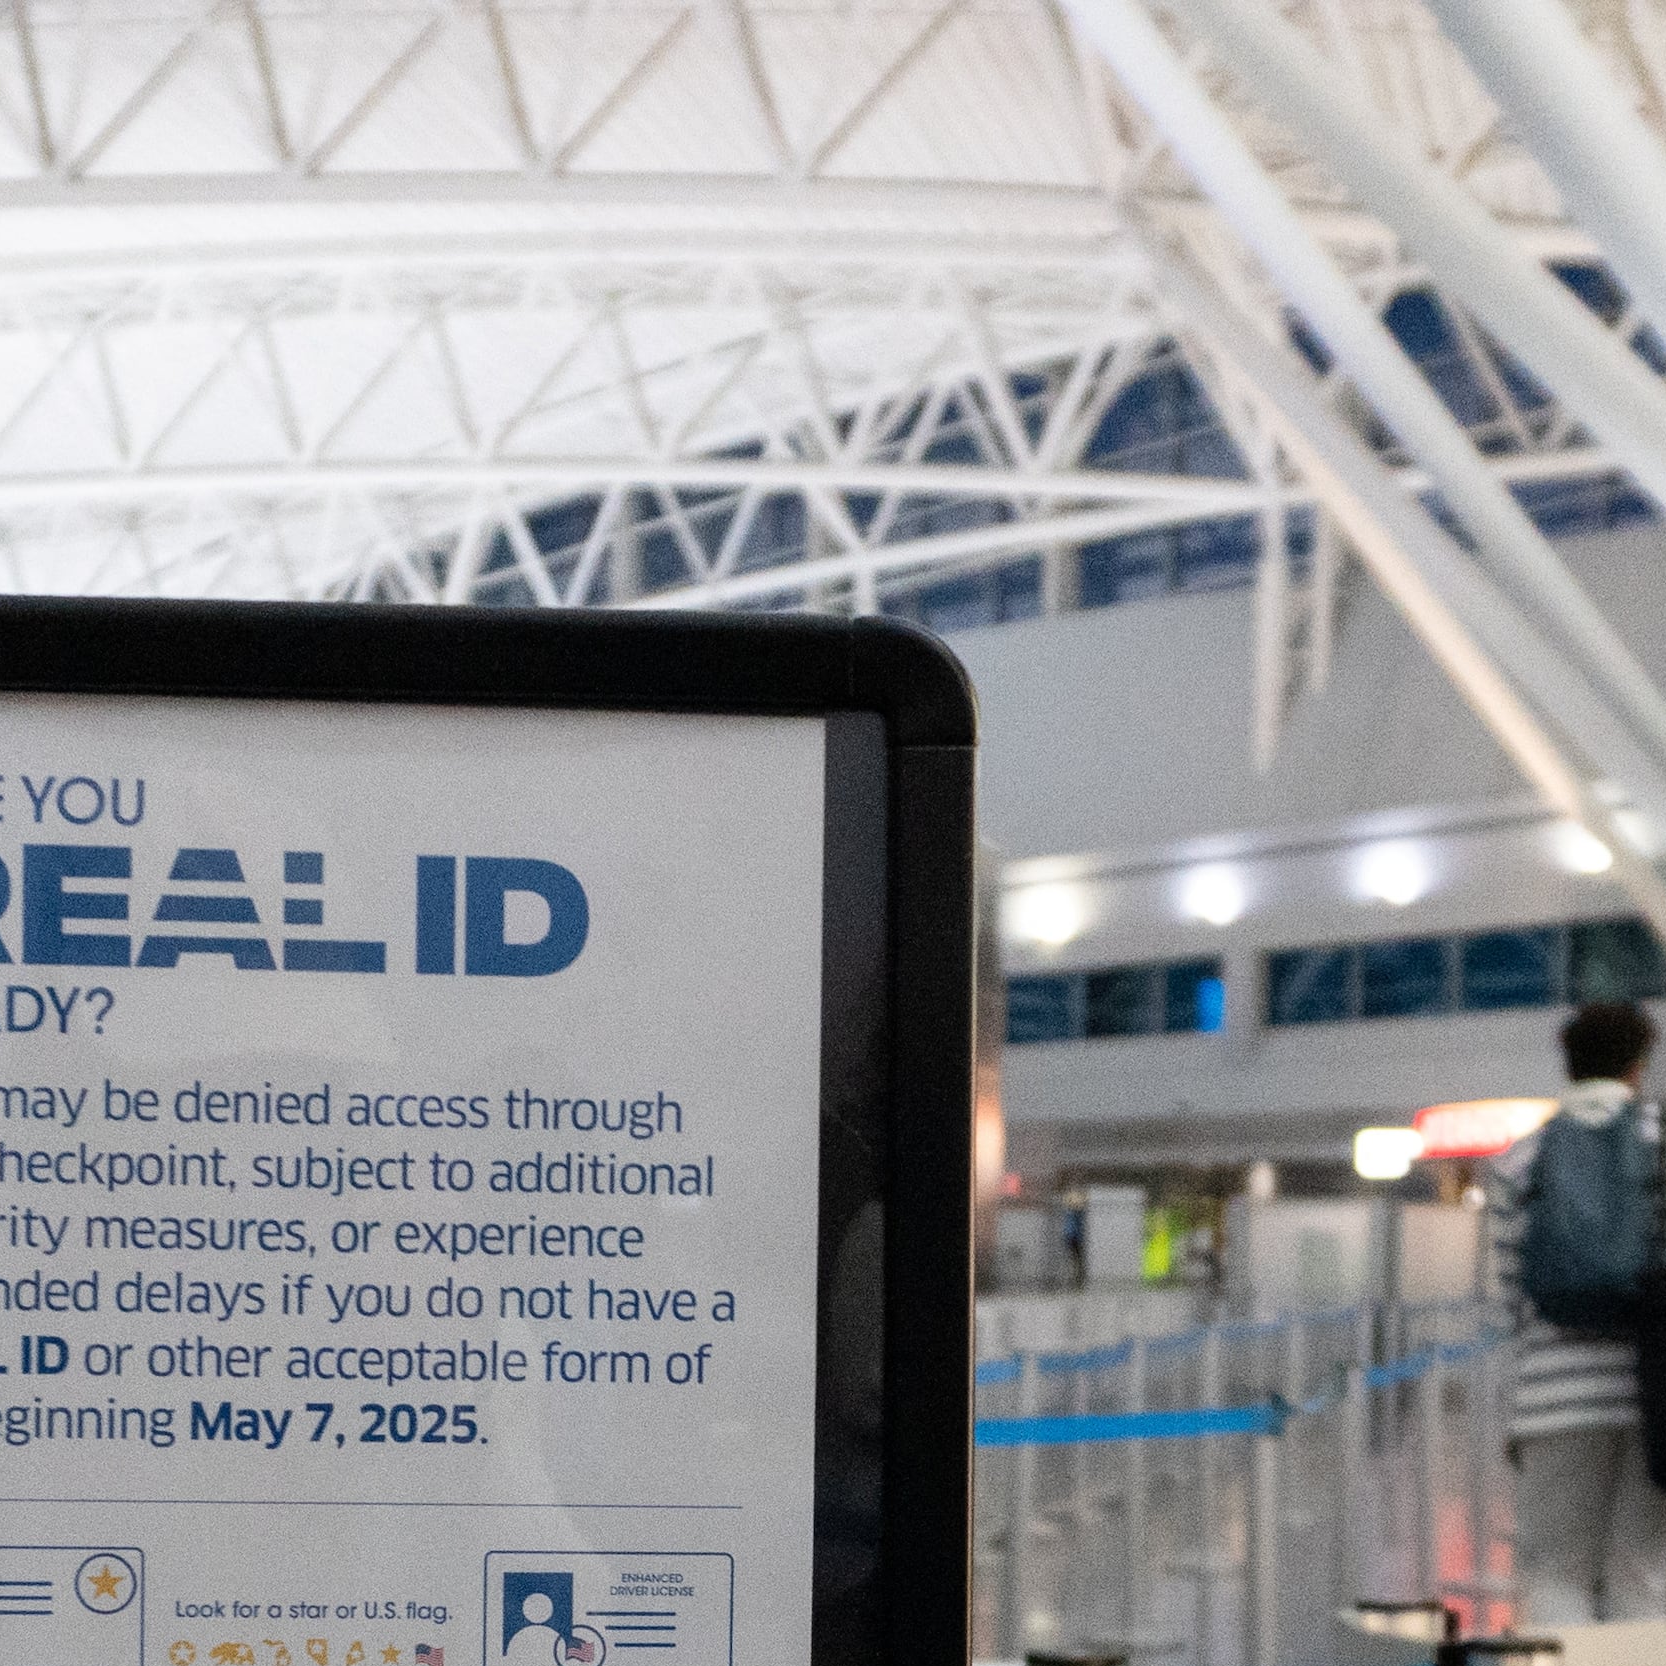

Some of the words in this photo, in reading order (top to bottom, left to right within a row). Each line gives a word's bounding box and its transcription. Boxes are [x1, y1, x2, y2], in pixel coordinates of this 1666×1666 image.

[21, 775, 145, 827] YOU
[416, 855, 590, 978] ID
[103, 1078, 160, 1123] be
[173, 1080, 331, 1126] denied
[345, 1093, 491, 1130] access
[504, 1088, 683, 1141] through
[252, 1146, 415, 1197] subject
[429, 1152, 475, 1193] to
[488, 1151, 714, 1196] additional
[85, 1215, 316, 1257] measures,
[331, 1219, 382, 1254] or
[394, 1214, 645, 1262] experience
[114, 1271, 266, 1323] delays
[282, 1273, 313, 1315] if
[325, 1283, 412, 1325] you
[426, 1276, 484, 1319] do
[499, 1281, 572, 1321] not
[588, 1279, 698, 1323] have
[710, 1289, 736, 1323] a
[21, 1335, 70, 1375] ID
[83, 1343, 134, 1377] or
[147, 1335, 272, 1379] other
[285, 1339, 528, 1387] acceptable
[542, 1340, 651, 1384] form
[665, 1343, 712, 1386] of
[190, 1401, 292, 1450] May
[305, 1402, 345, 1447] 7,
[359, 1402, 487, 1444] 2025.
[610, 1585, 648, 1597] DRIVER
[650, 1585, 694, 1597] LICENSE
[621, 1572, 684, 1584] ENHANCED
[175, 1600, 226, 1619] Look
[231, 1600, 261, 1619] for
[266, 1604, 283, 1620] a
[289, 1601, 329, 1620] star
[334, 1604, 358, 1620] or
[364, 1600, 401, 1620] U.S.
[405, 1601, 453, 1625] flag.
